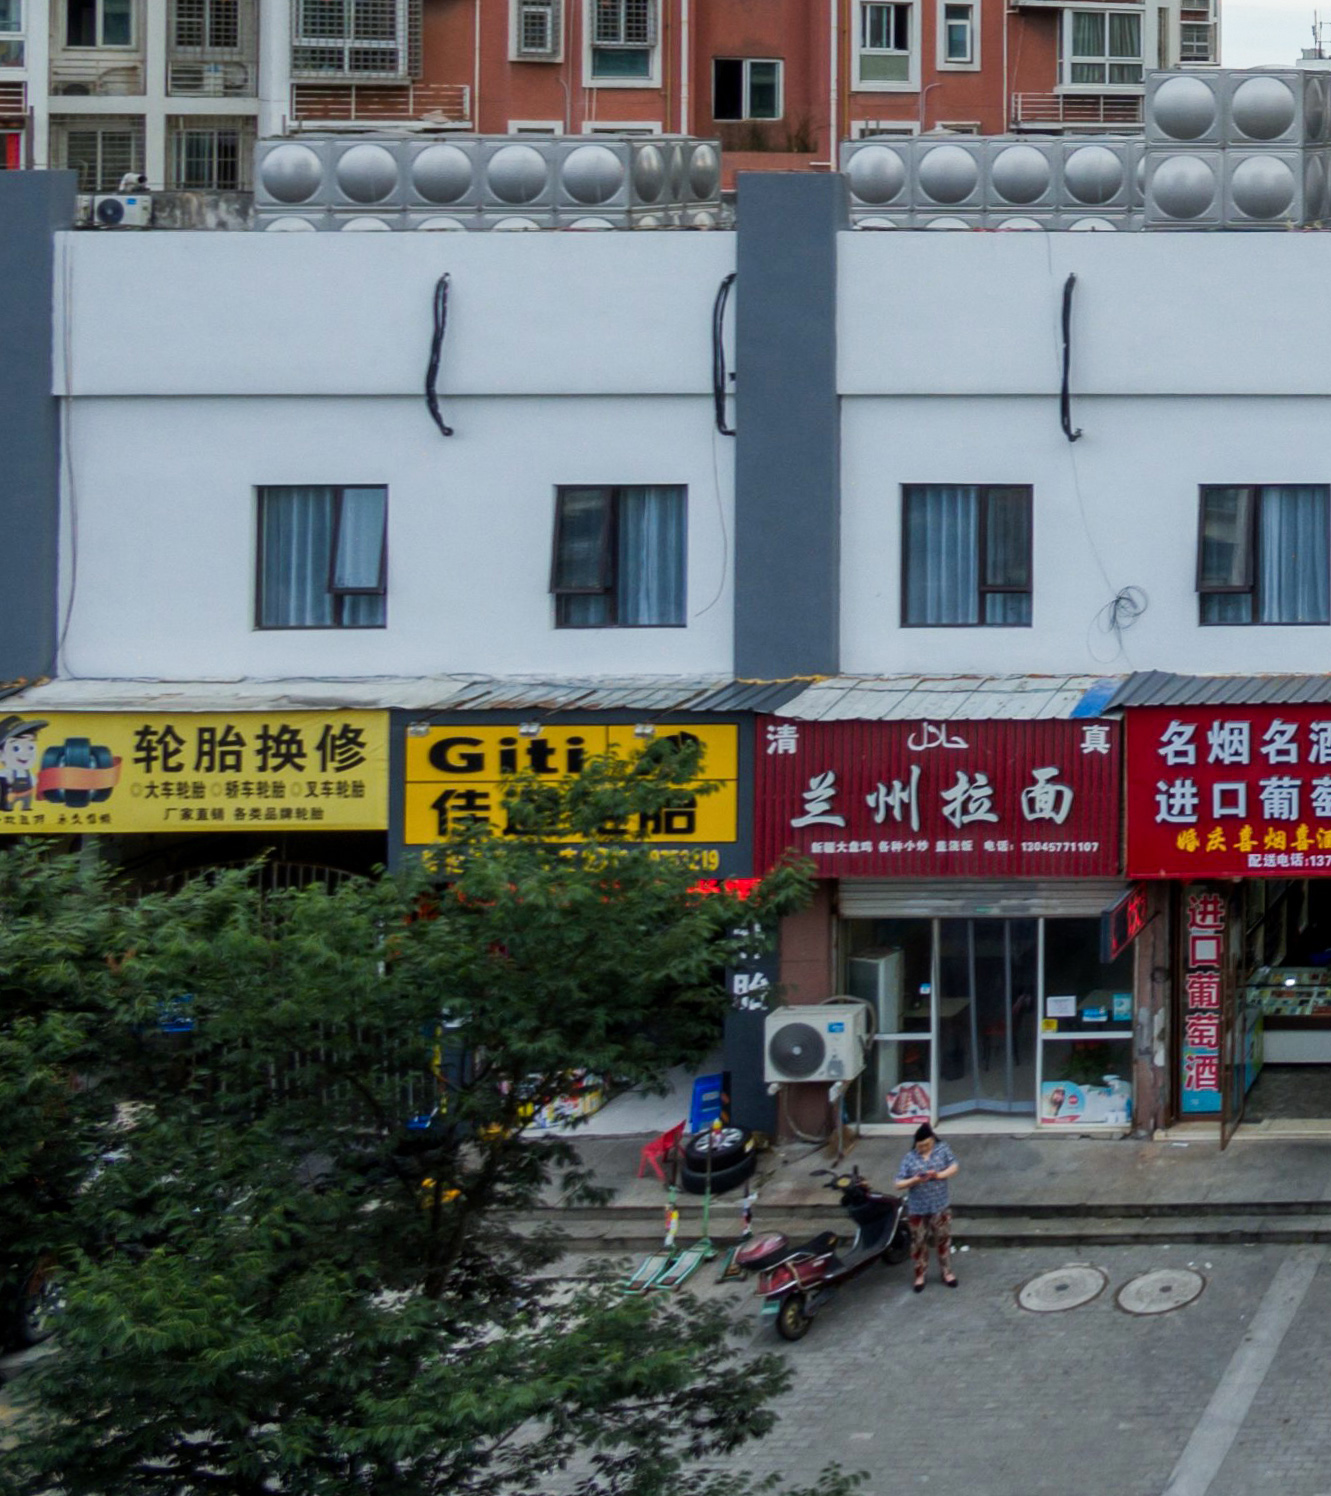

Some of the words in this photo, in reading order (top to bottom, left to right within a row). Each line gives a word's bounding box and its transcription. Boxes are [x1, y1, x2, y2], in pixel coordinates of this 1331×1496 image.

[133, 723, 368, 774] 轮胎换修
[428, 736, 586, 774] Giti
[766, 724, 799, 755] 清
[1080, 724, 1112, 755] 真
[144, 780, 206, 799] 大车轮胎
[225, 780, 286, 799] 轿车轮胎
[304, 780, 366, 799] 叉车轮胎
[790, 763, 1075, 833] 兰州拉面
[164, 807, 225, 822] 厂家直销
[234, 807, 324, 822] 各类品牌轮胎
[1184, 893, 1225, 1091] 进口葡萄酒
